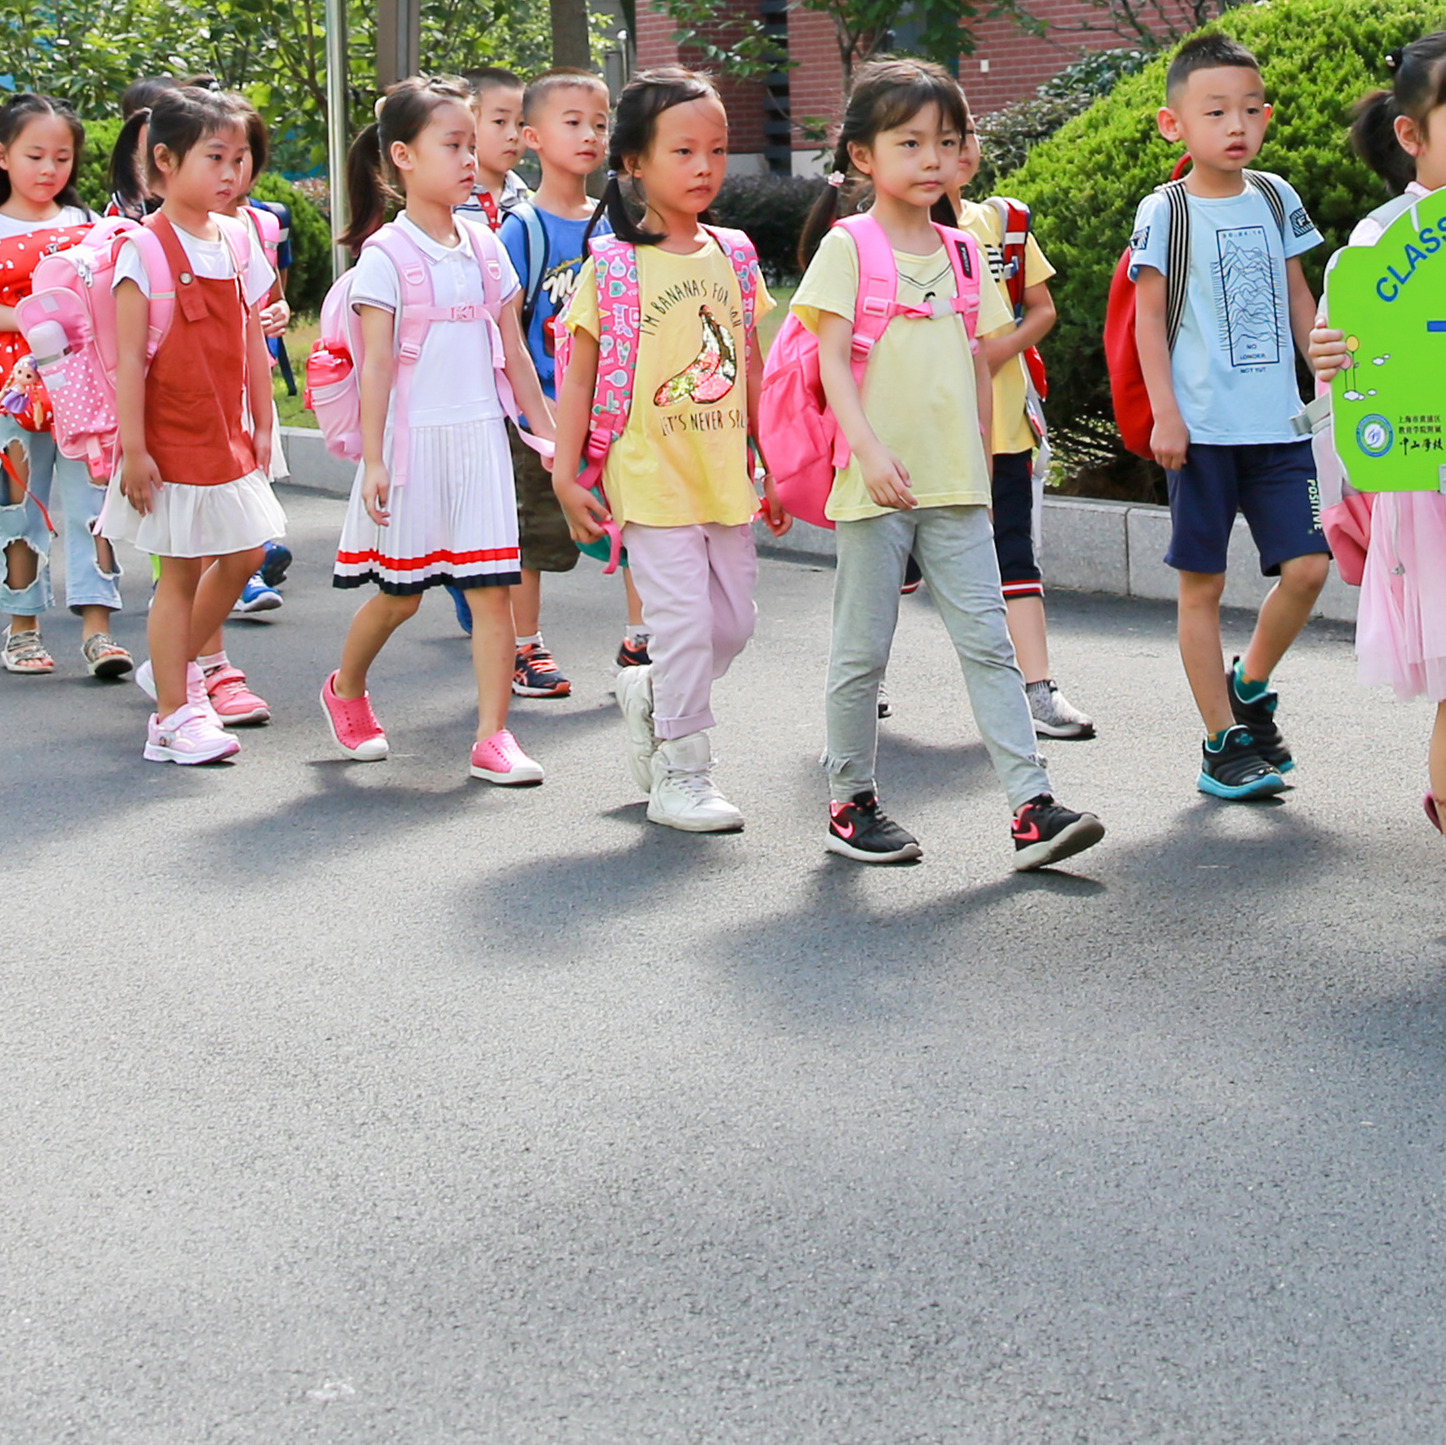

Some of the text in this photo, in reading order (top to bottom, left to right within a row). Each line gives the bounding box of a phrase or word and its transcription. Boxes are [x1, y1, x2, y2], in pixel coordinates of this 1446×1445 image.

[650, 279, 707, 315] BANANAS
[690, 409, 724, 432] NEVER
[1307, 479, 1323, 530] POSITIVE
